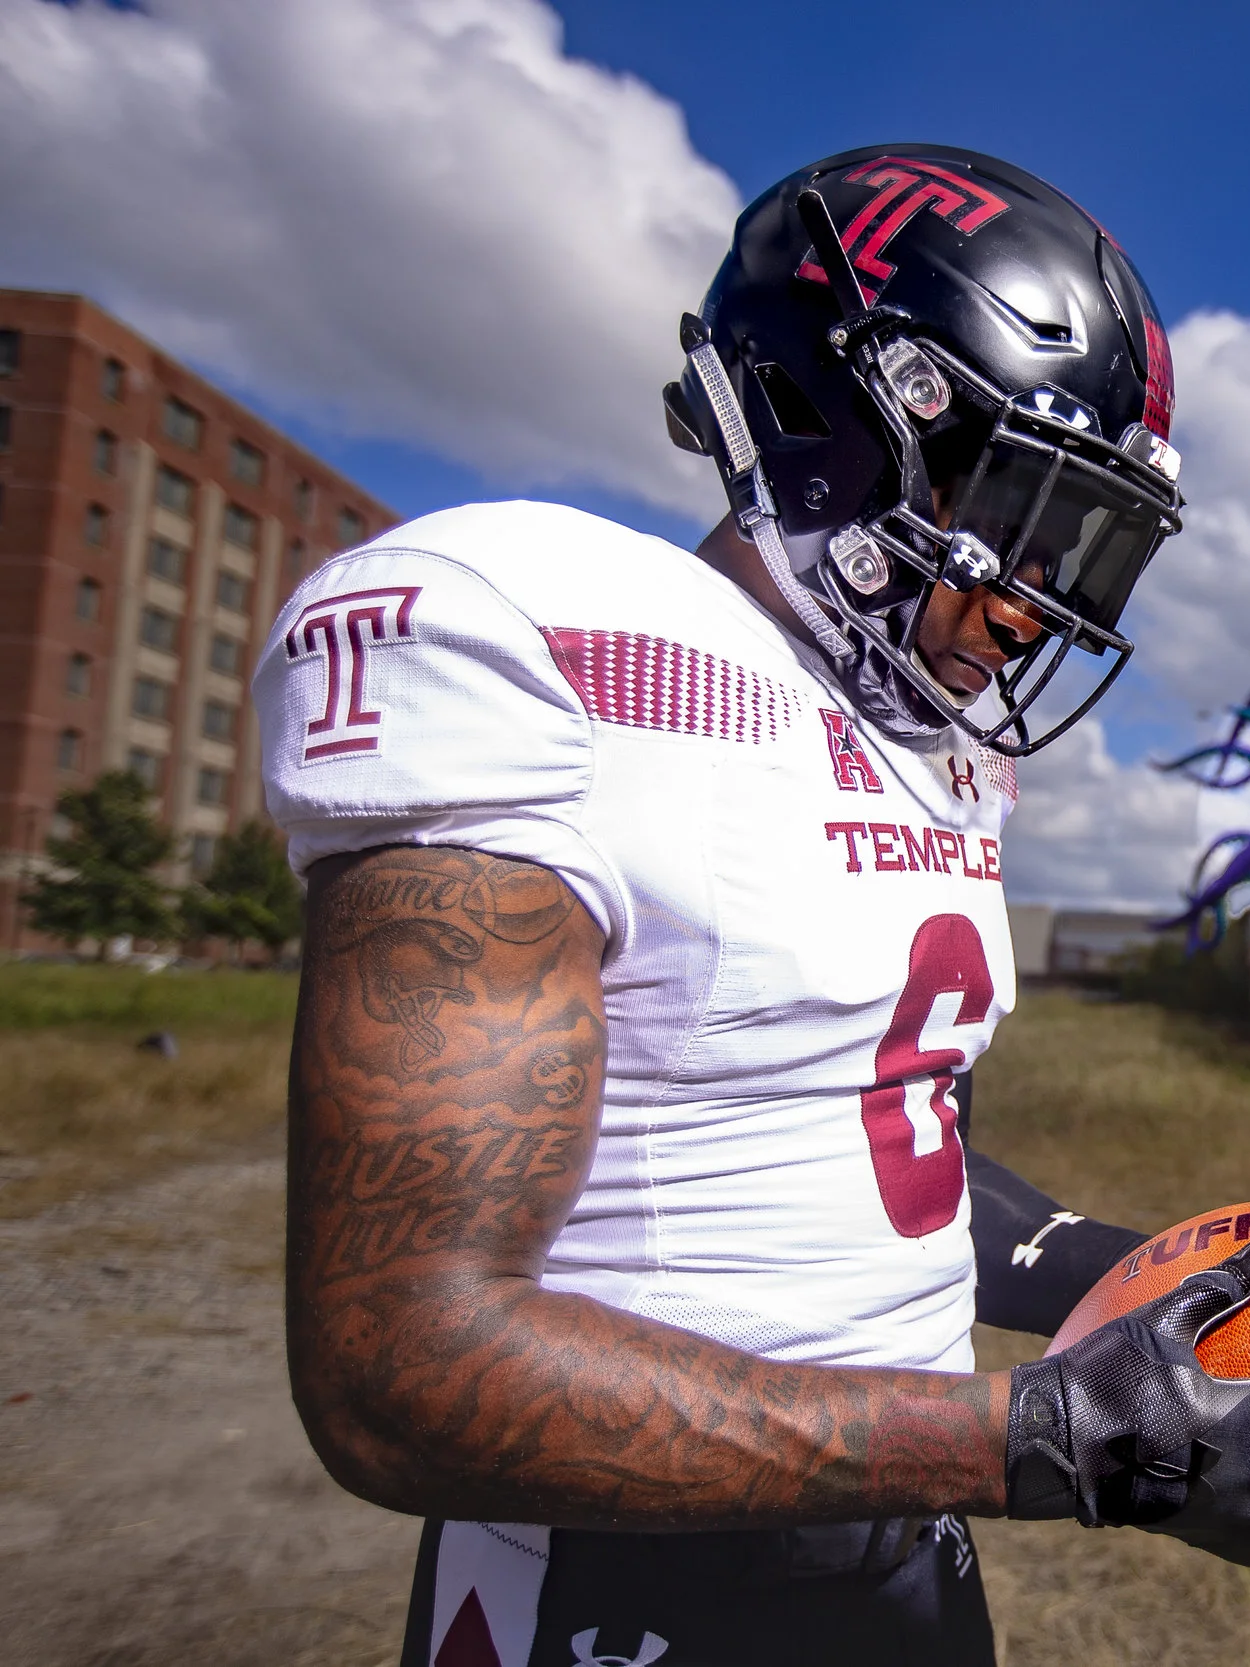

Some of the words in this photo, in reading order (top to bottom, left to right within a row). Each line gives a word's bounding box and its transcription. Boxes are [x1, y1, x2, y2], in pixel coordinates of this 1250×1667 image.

[286, 586, 423, 761] T
[824, 821, 1002, 882] TEMPLE
[861, 913, 994, 1238] 6
[314, 1127, 578, 1200] HUSTLE
[318, 1195, 523, 1275] LUCK
